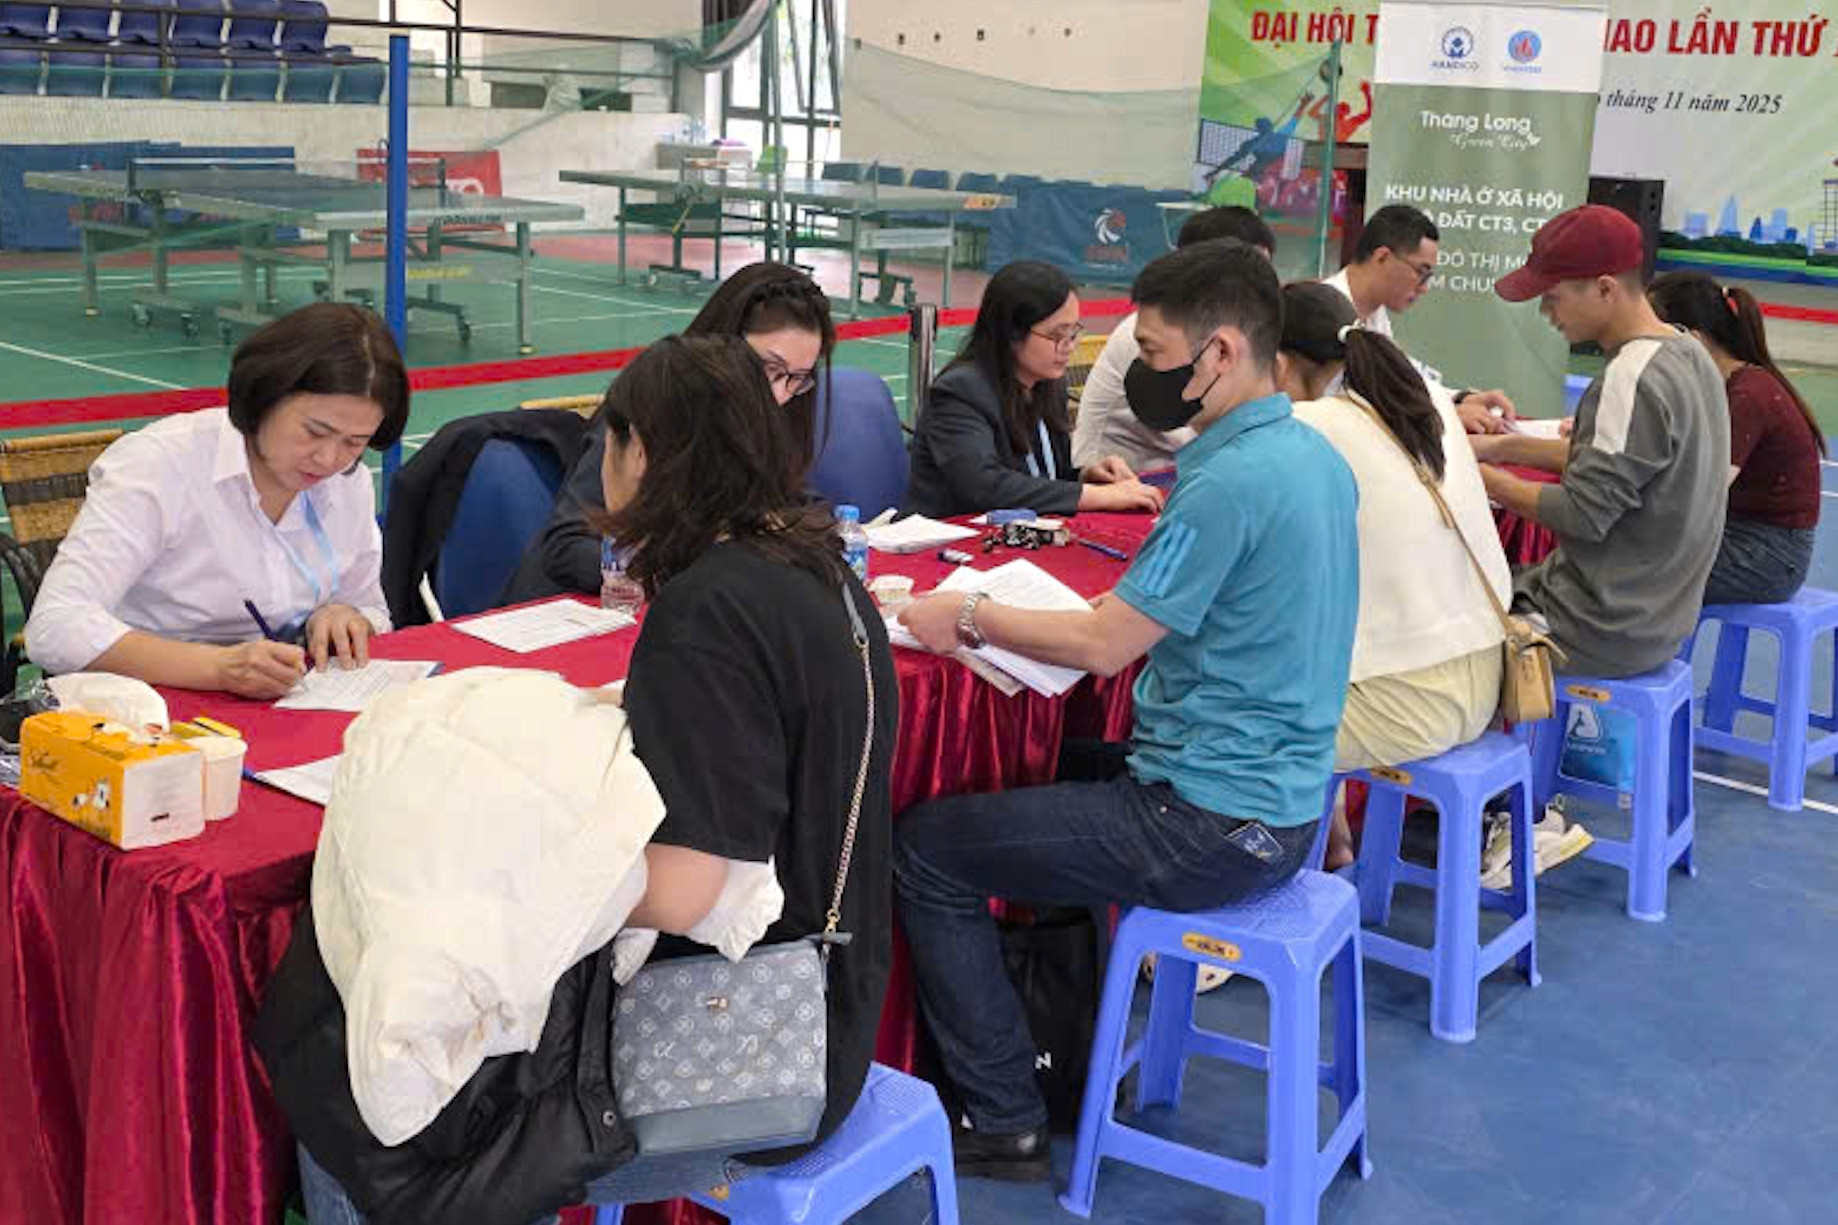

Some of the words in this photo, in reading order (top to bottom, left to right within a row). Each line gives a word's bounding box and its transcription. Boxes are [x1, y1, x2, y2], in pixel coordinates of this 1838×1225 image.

[1250, 11, 1298, 48] ĐẠI
[1667, 6, 1740, 55] LẦN
[1752, 14, 1830, 57] THỨ
[1606, 89, 1659, 114] tháng
[1664, 90, 1684, 110] 11
[1688, 94, 1730, 111] năm
[1735, 94, 1783, 114] 2025
[1484, 112, 1531, 135] Long
[1385, 184, 1427, 201] KHU
[1429, 184, 1472, 203] NHÀ
[1496, 188, 1523, 207] XÃ
[1527, 190, 1564, 212] HỘI
[1437, 209, 1475, 229] ĐẤT
